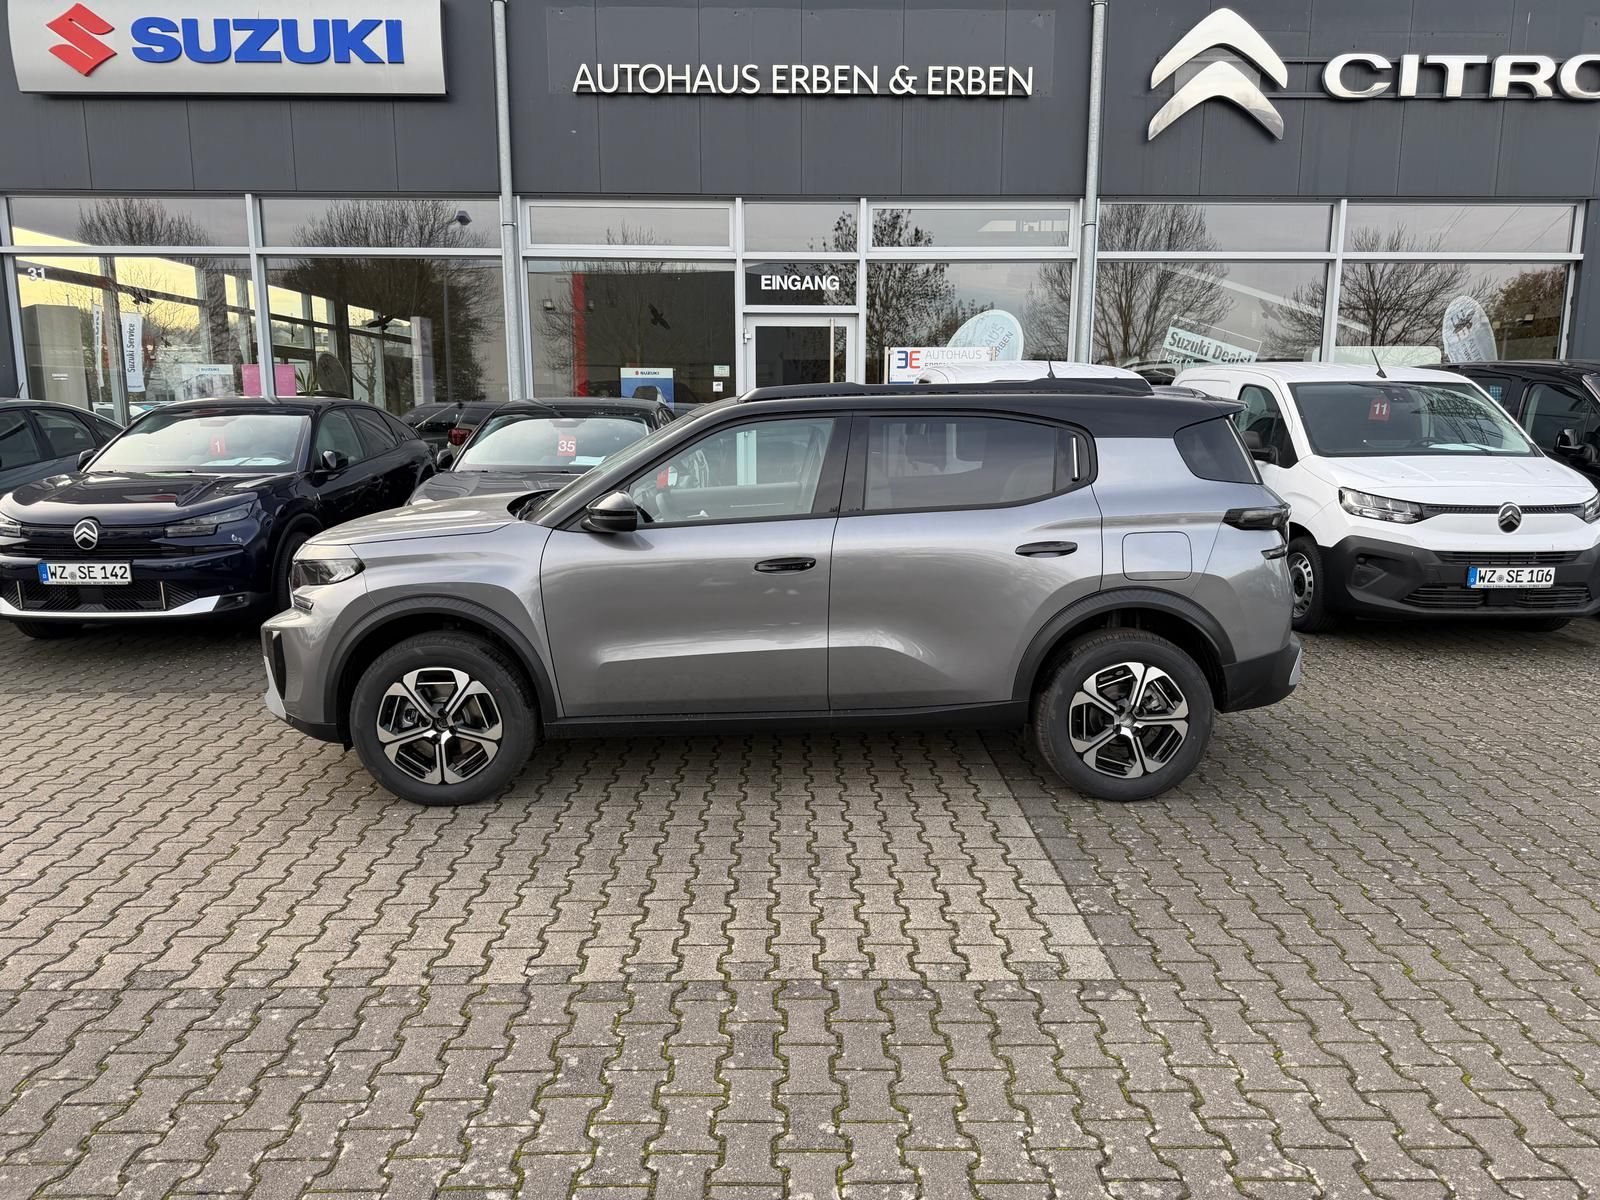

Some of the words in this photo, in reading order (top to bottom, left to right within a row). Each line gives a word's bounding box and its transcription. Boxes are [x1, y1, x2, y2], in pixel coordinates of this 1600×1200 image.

[131, 16, 405, 65] SUZUKI
[572, 63, 761, 94] AUTOHAUS
[772, 64, 879, 95] ERBEN
[889, 65, 918, 95] &
[927, 65, 1033, 96] ERBEN
[27, 267, 46, 281] 31
[761, 274, 840, 291] EINGANG
[126, 323, 136, 349] Service
[1168, 331, 1212, 357] Suzuki
[127, 350, 136, 373] Suzuki
[925, 350, 982, 360] AUTOHAUS
[1374, 402, 1387, 416] 11
[559, 440, 575, 452] 35
[48, 565, 68, 579] WZ
[78, 565, 97, 580] SE
[100, 565, 128, 580] 142
[1478, 569, 1497, 583] WZ
[1506, 569, 1525, 583] SE
[1527, 569, 1553, 583] 106
